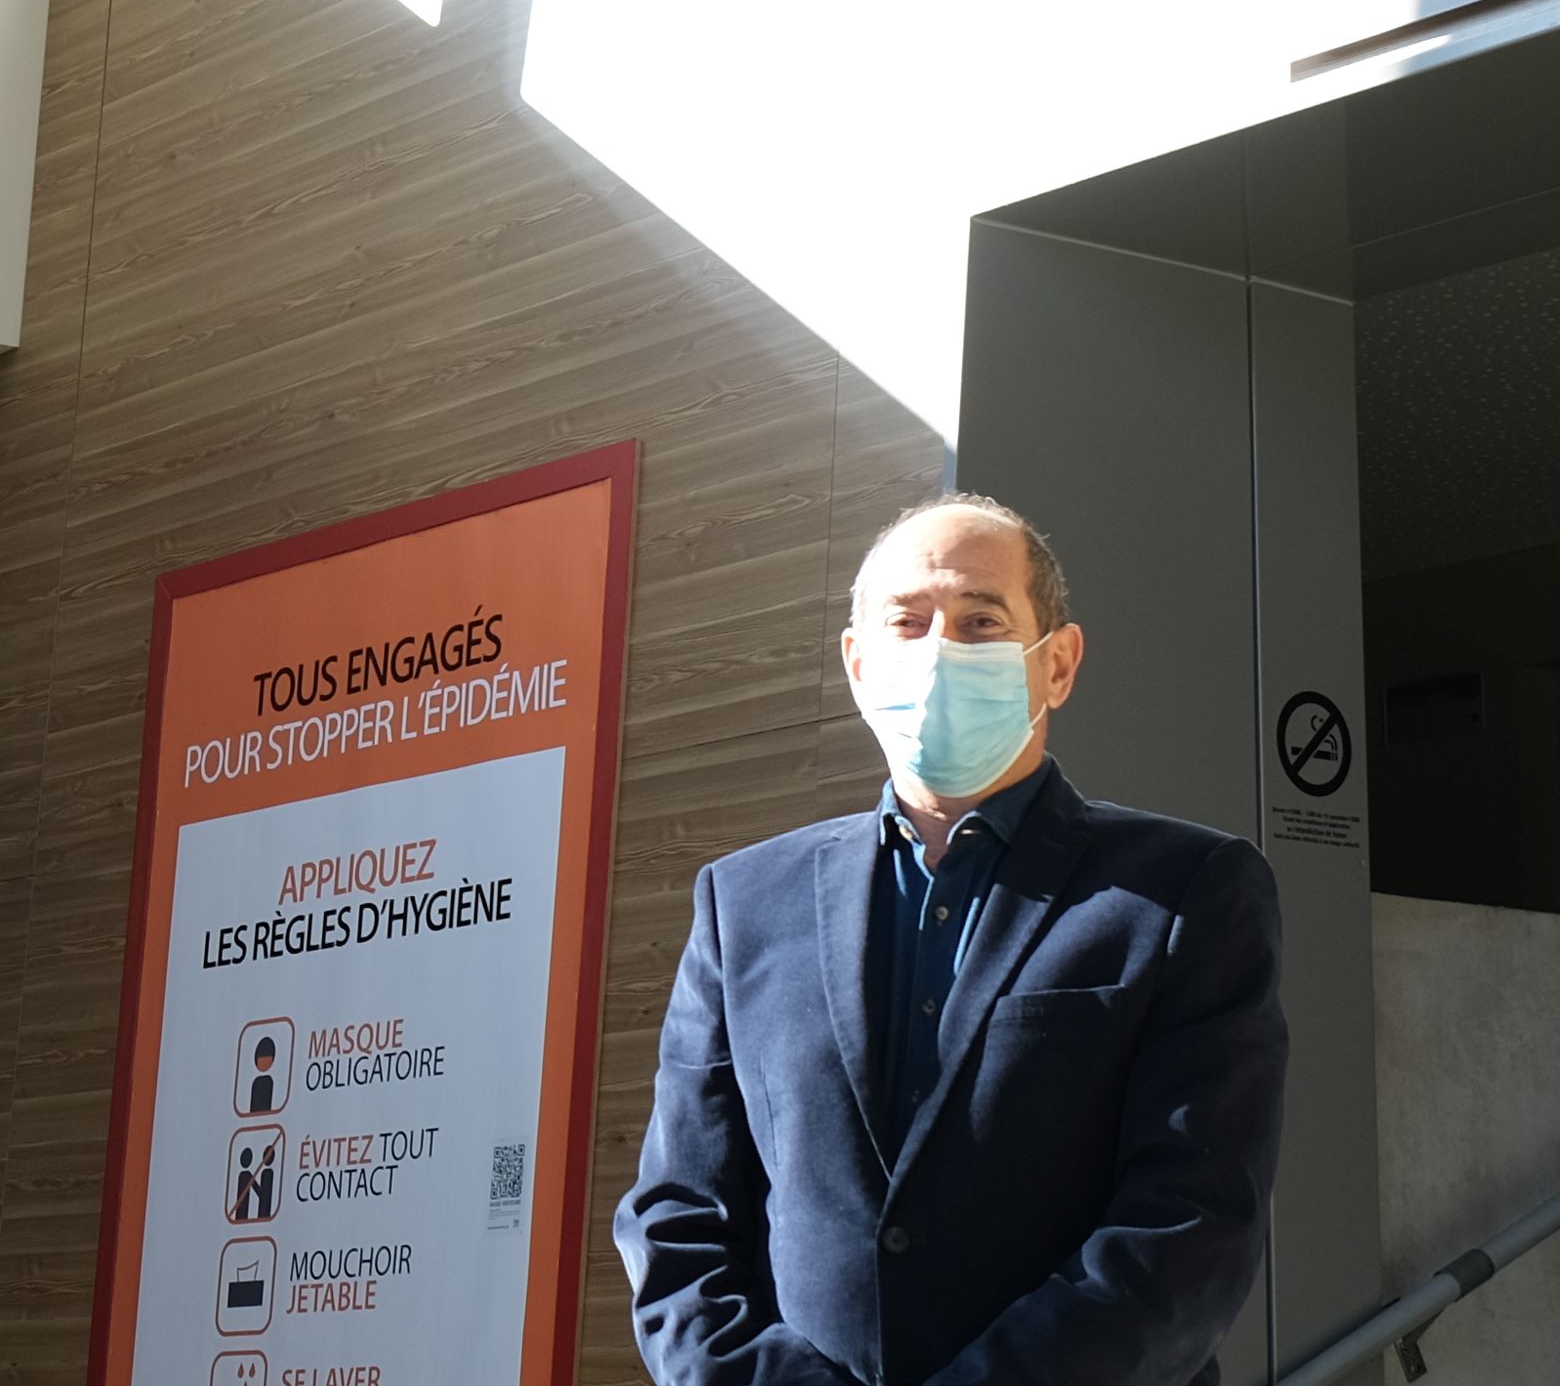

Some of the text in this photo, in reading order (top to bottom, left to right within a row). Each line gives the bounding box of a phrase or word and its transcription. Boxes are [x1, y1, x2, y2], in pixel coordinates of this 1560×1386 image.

[254, 605, 503, 717] TOUS ENGAGÉS
[185, 659, 567, 788] POUR STOPPER L'ÉPIDÉMIE
[278, 839, 437, 905] APPLIQUEZ
[203, 877, 512, 969] LES RÈGLES D'HYGIÈNE
[309, 1019, 403, 1059] MASQUE
[306, 1046, 445, 1091] OBLIGATOIRE
[300, 1127, 439, 1170] ÉVITEZ TOUT
[297, 1165, 398, 1202] CONTACT
[290, 1244, 411, 1282] MOUCHOIR
[286, 1280, 377, 1315] JETABLE
